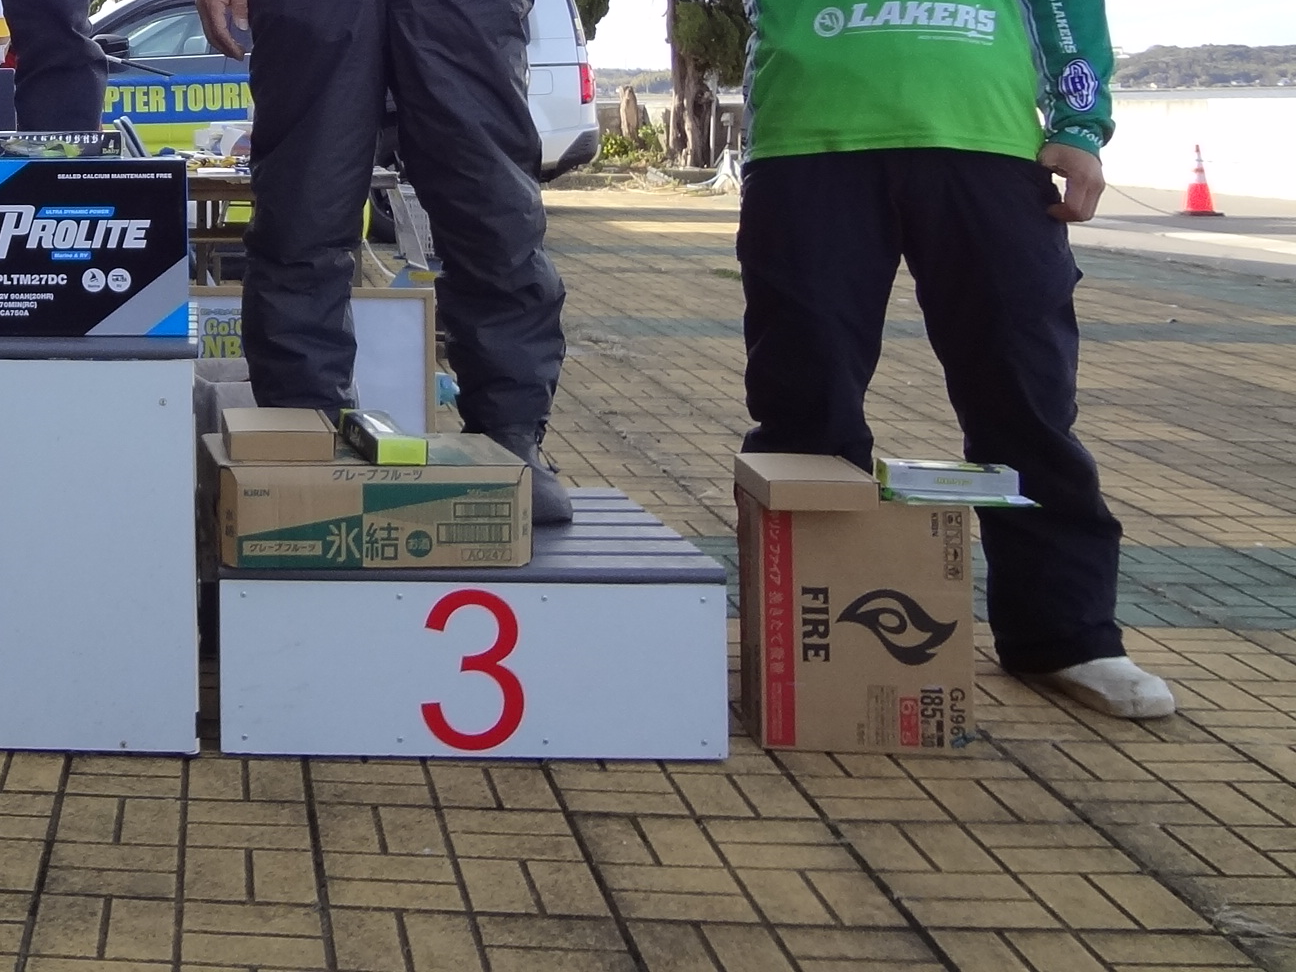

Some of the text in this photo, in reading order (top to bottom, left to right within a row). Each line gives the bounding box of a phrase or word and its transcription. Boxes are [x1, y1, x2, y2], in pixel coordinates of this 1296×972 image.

[103, 85, 167, 113] PTER
[332, 469, 423, 481] グレープフルーツ
[243, 488, 270, 497] KIRIN
[249, 542, 317, 554] グレープフルーツ
[326, 522, 400, 562] 氷結
[801, 586, 831, 663] FIRE
[419, 588, 527, 753] 3
